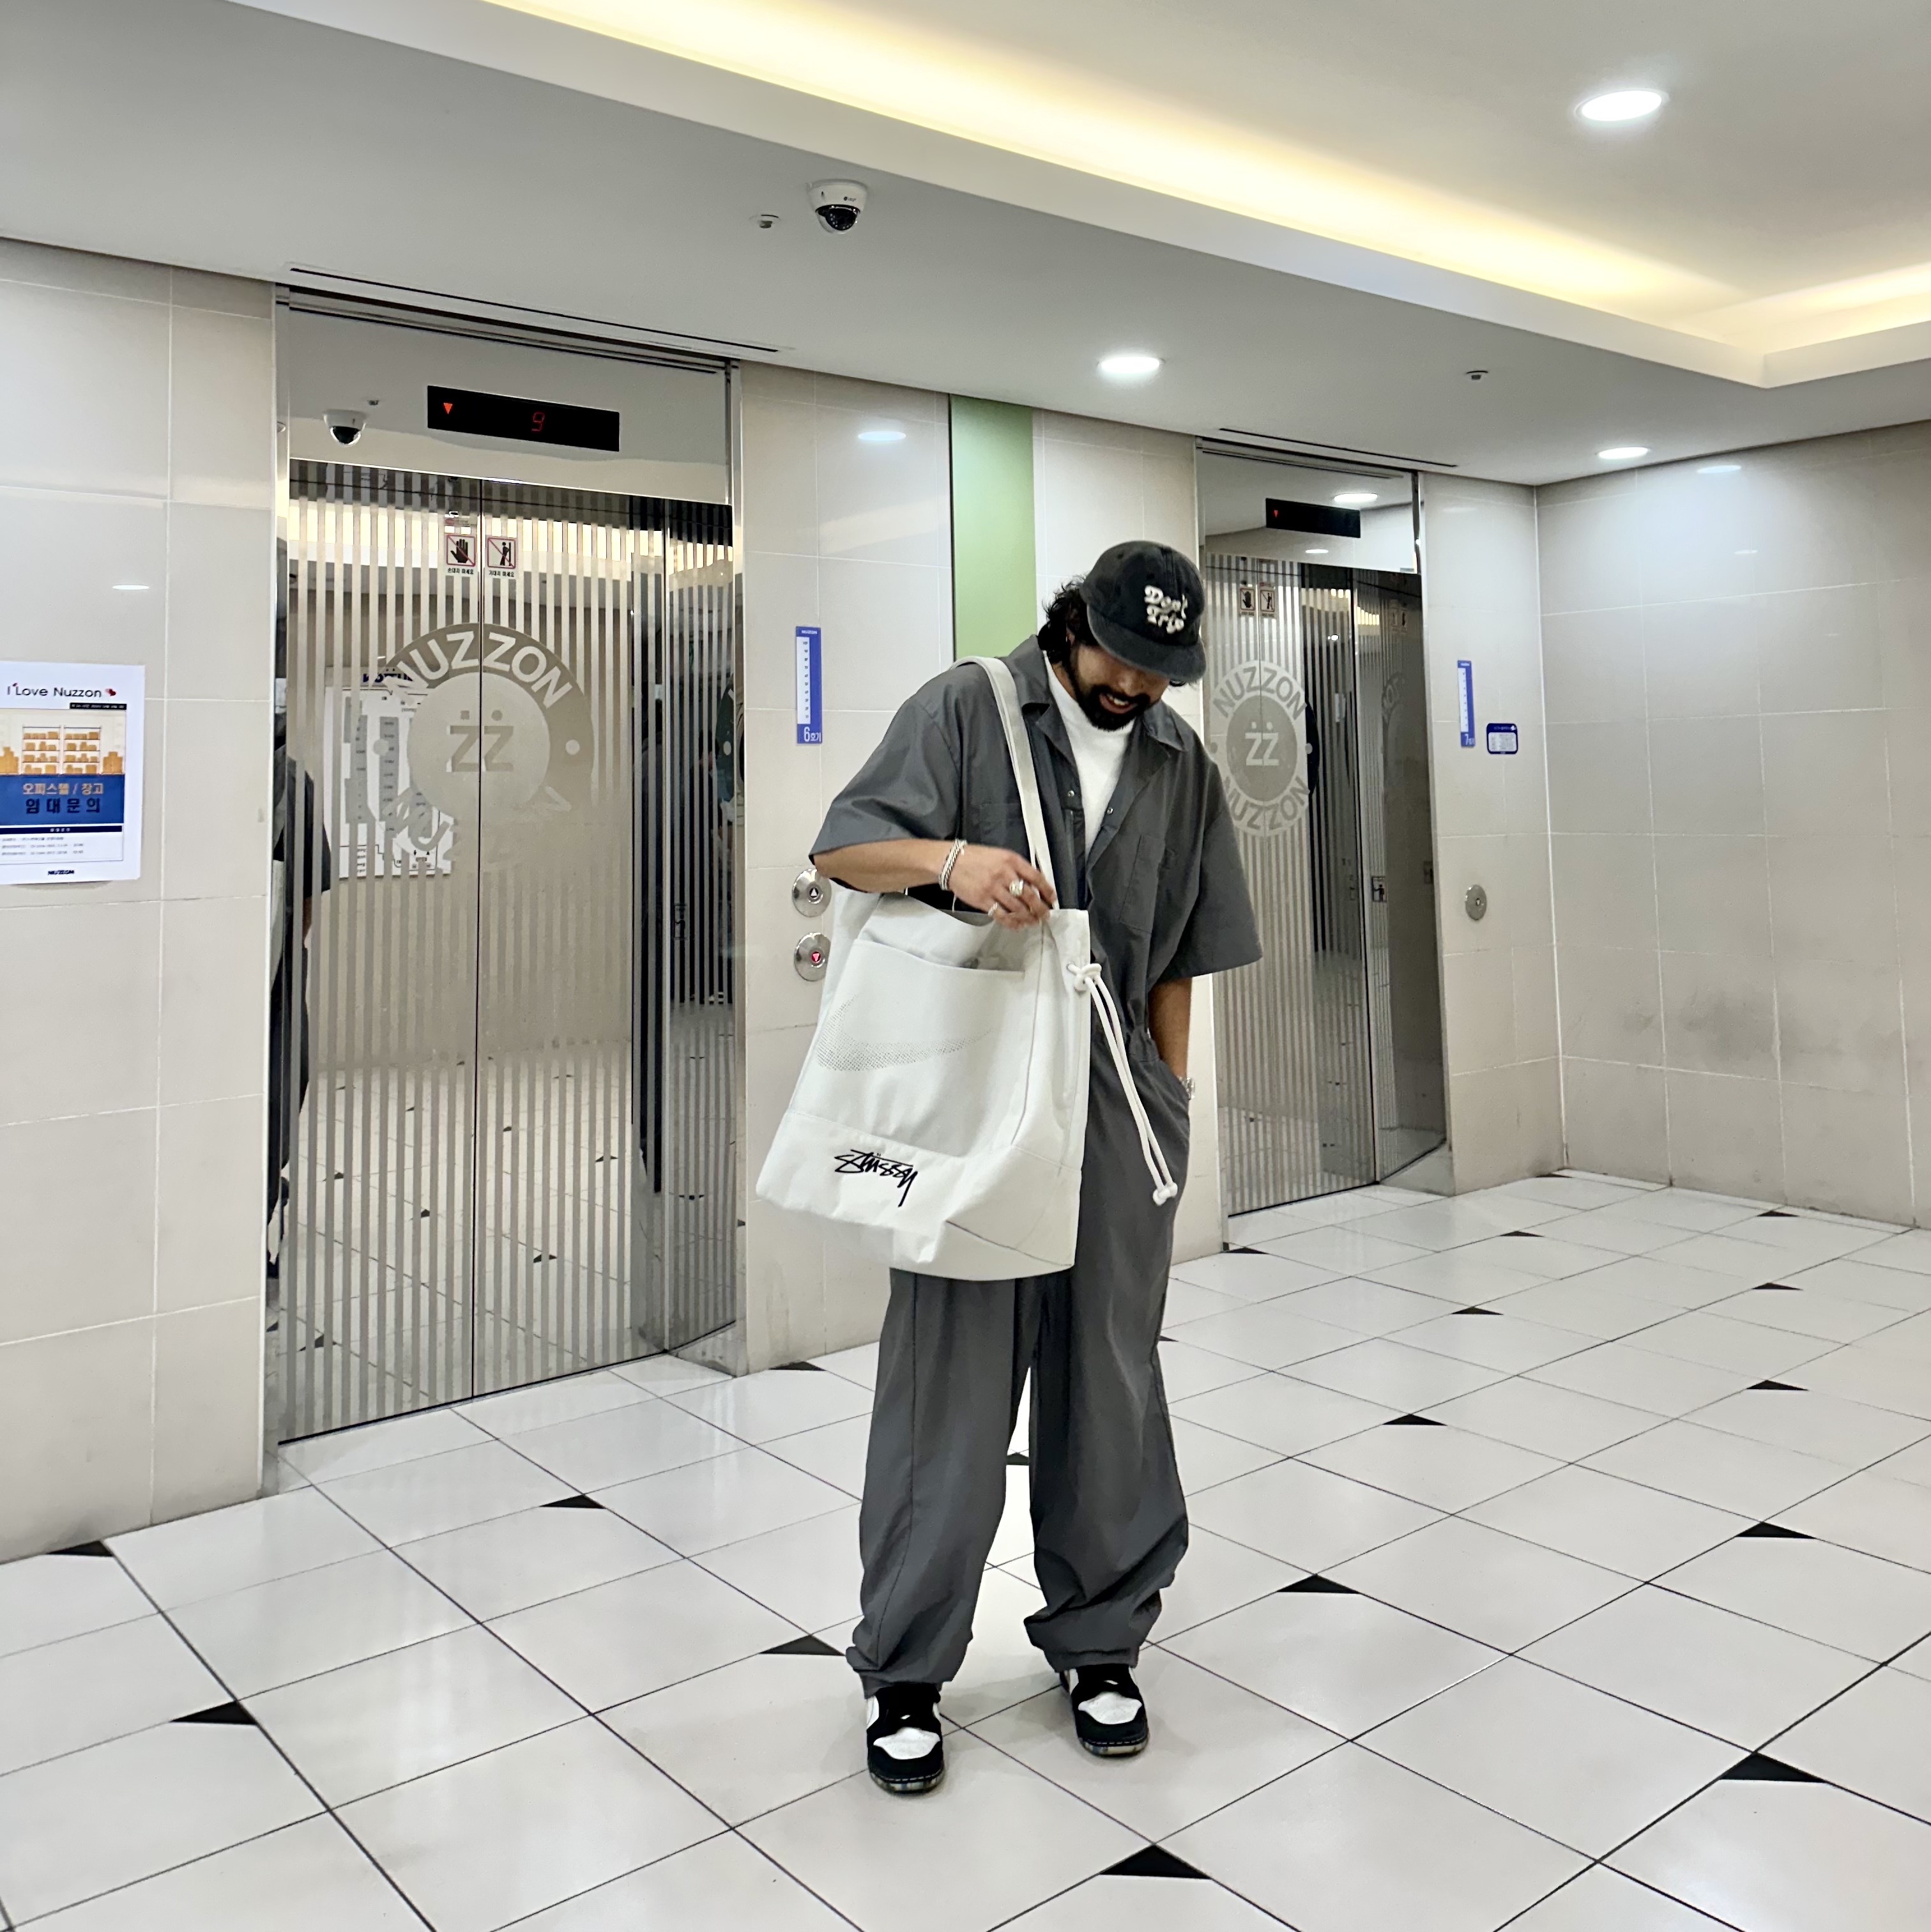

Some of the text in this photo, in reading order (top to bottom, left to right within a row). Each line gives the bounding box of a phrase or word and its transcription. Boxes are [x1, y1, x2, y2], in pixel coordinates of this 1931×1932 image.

[531, 411, 545, 432] 9
[383, 631, 573, 709] NUZZON
[15, 686, 48, 696] Love
[53, 687, 102, 698] Nuzzon
[1214, 666, 1308, 720] NUZZON
